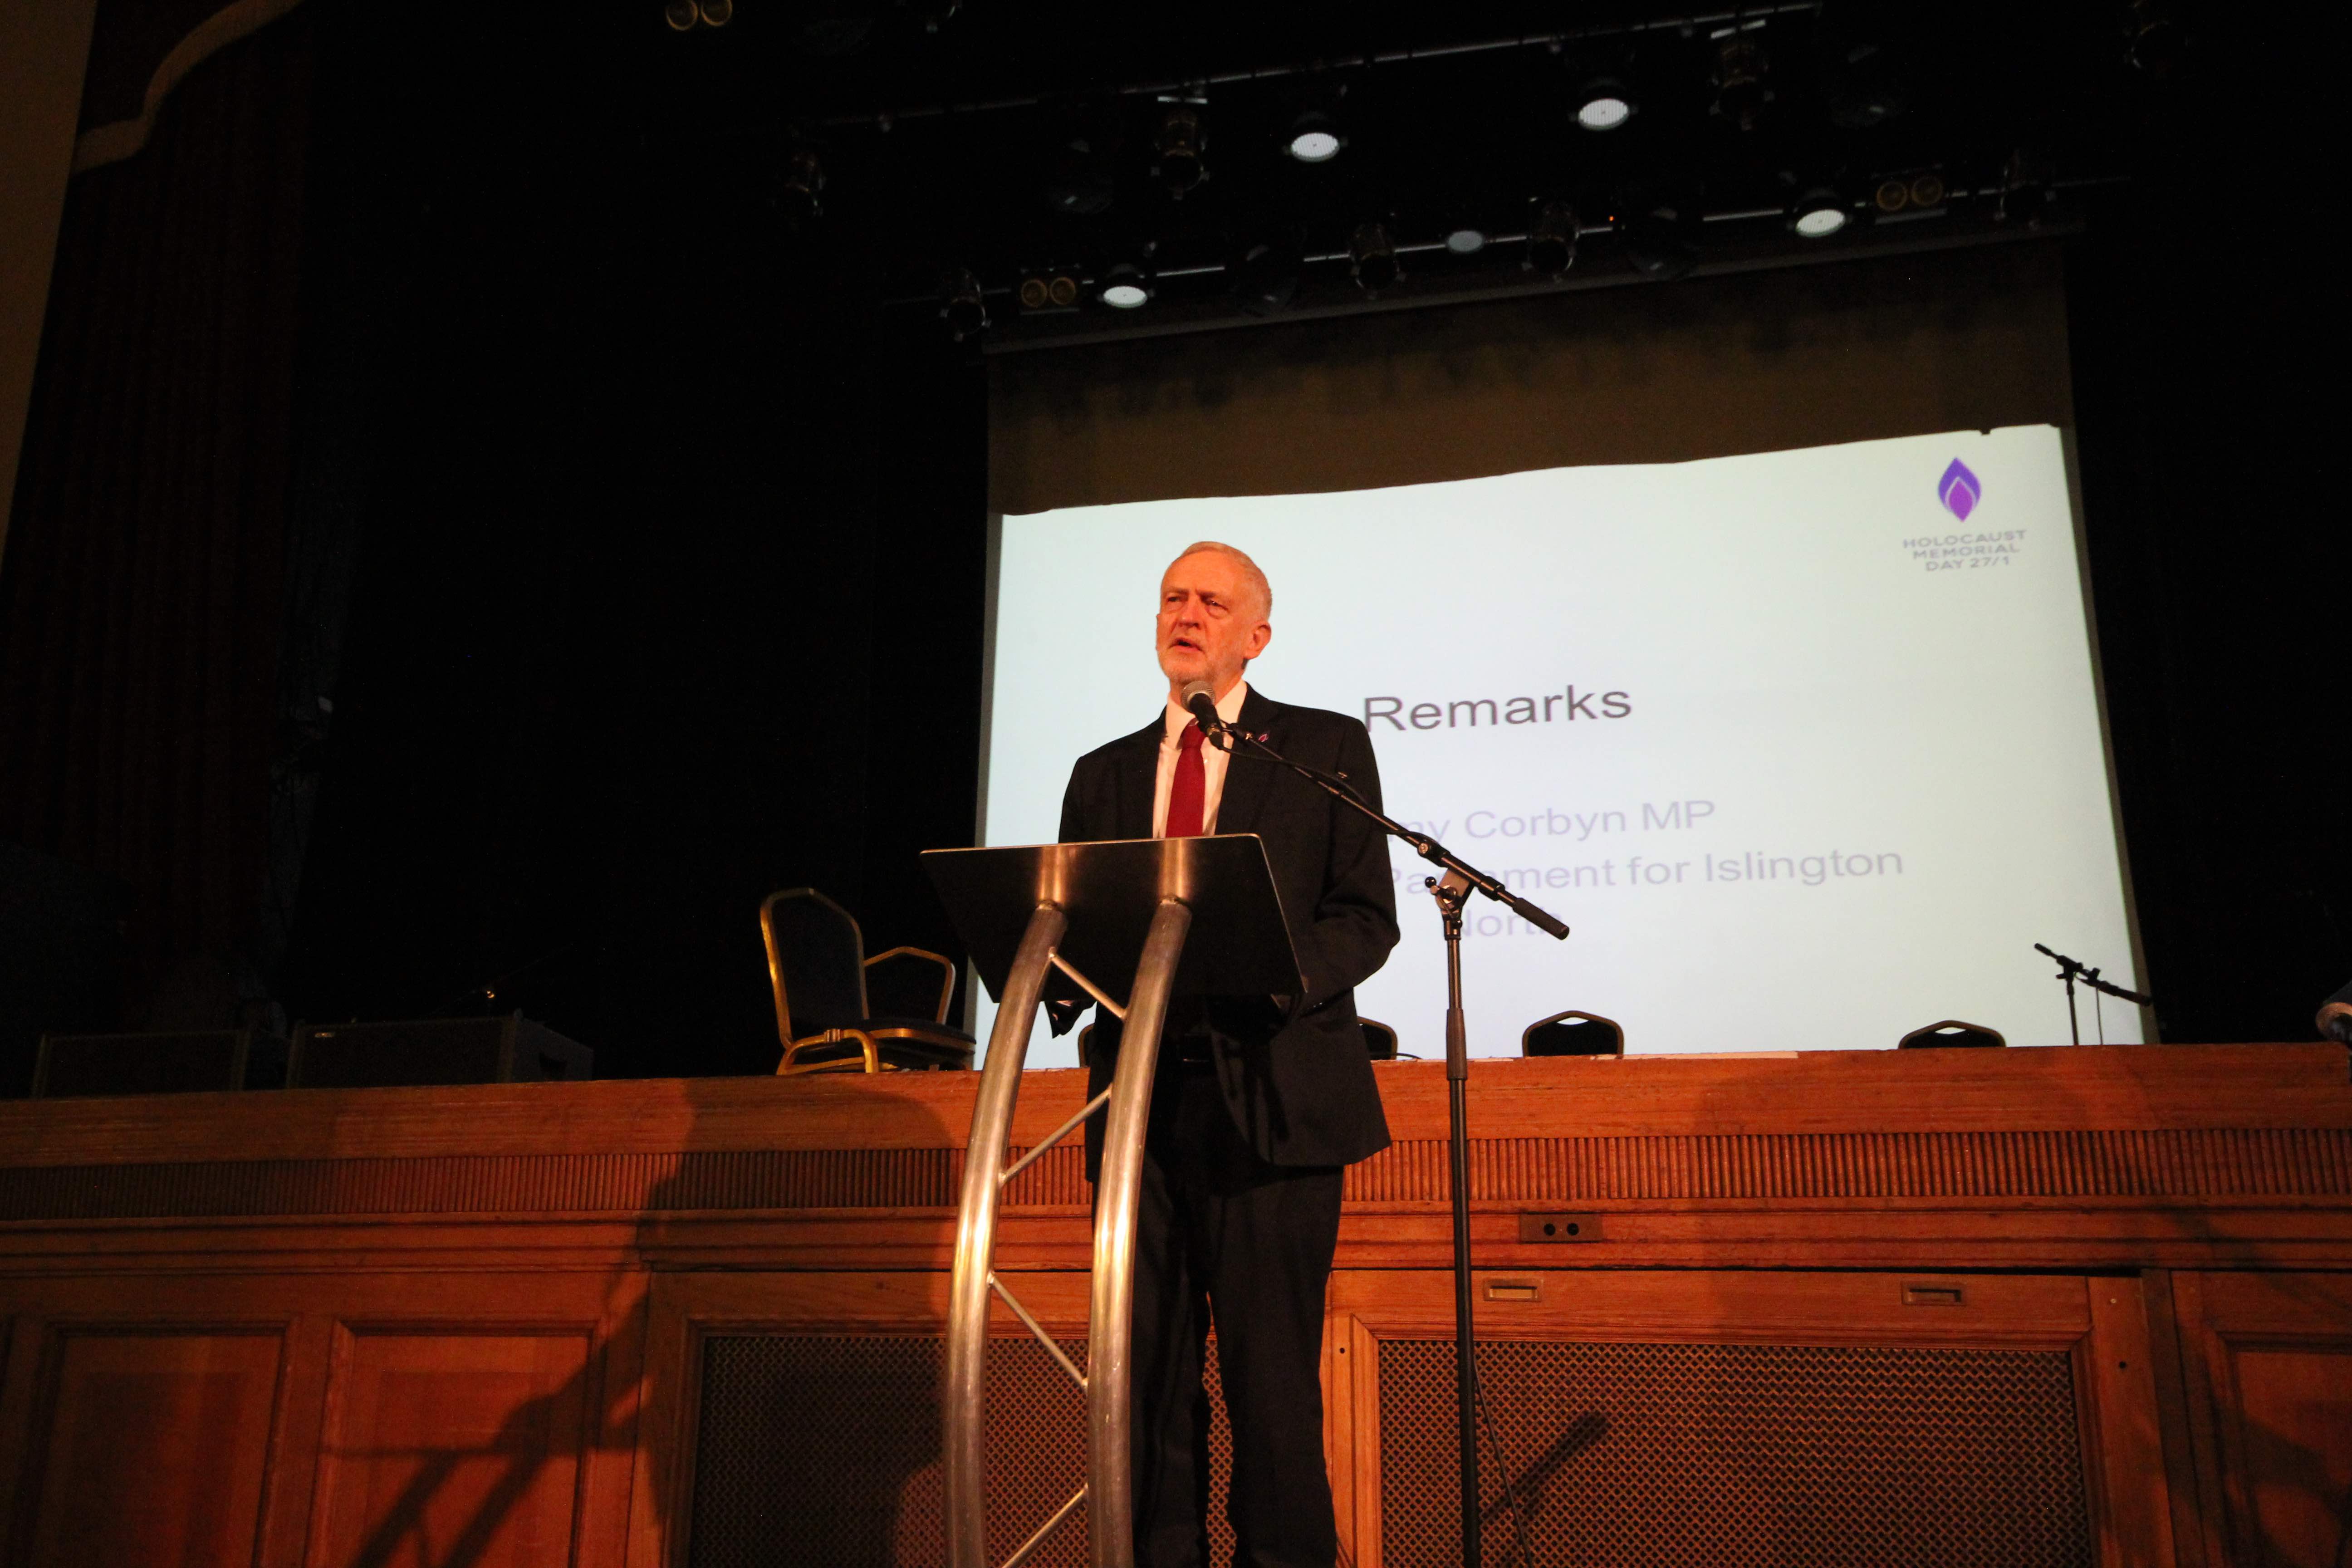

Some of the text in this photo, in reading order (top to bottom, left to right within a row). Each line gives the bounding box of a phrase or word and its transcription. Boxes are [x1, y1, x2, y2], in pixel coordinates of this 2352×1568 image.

[1903, 530, 2027, 548] HOLOCAUST
[1913, 543, 2021, 559] MEMORIAL
[1926, 556, 2009, 572] DAY 27/1
[1363, 685, 1632, 731] Remarks
[1465, 808, 1627, 842] Corbyn
[1642, 800, 1715, 830] MP
[1627, 856, 1691, 885] for
[1705, 849, 1903, 886] Islington
